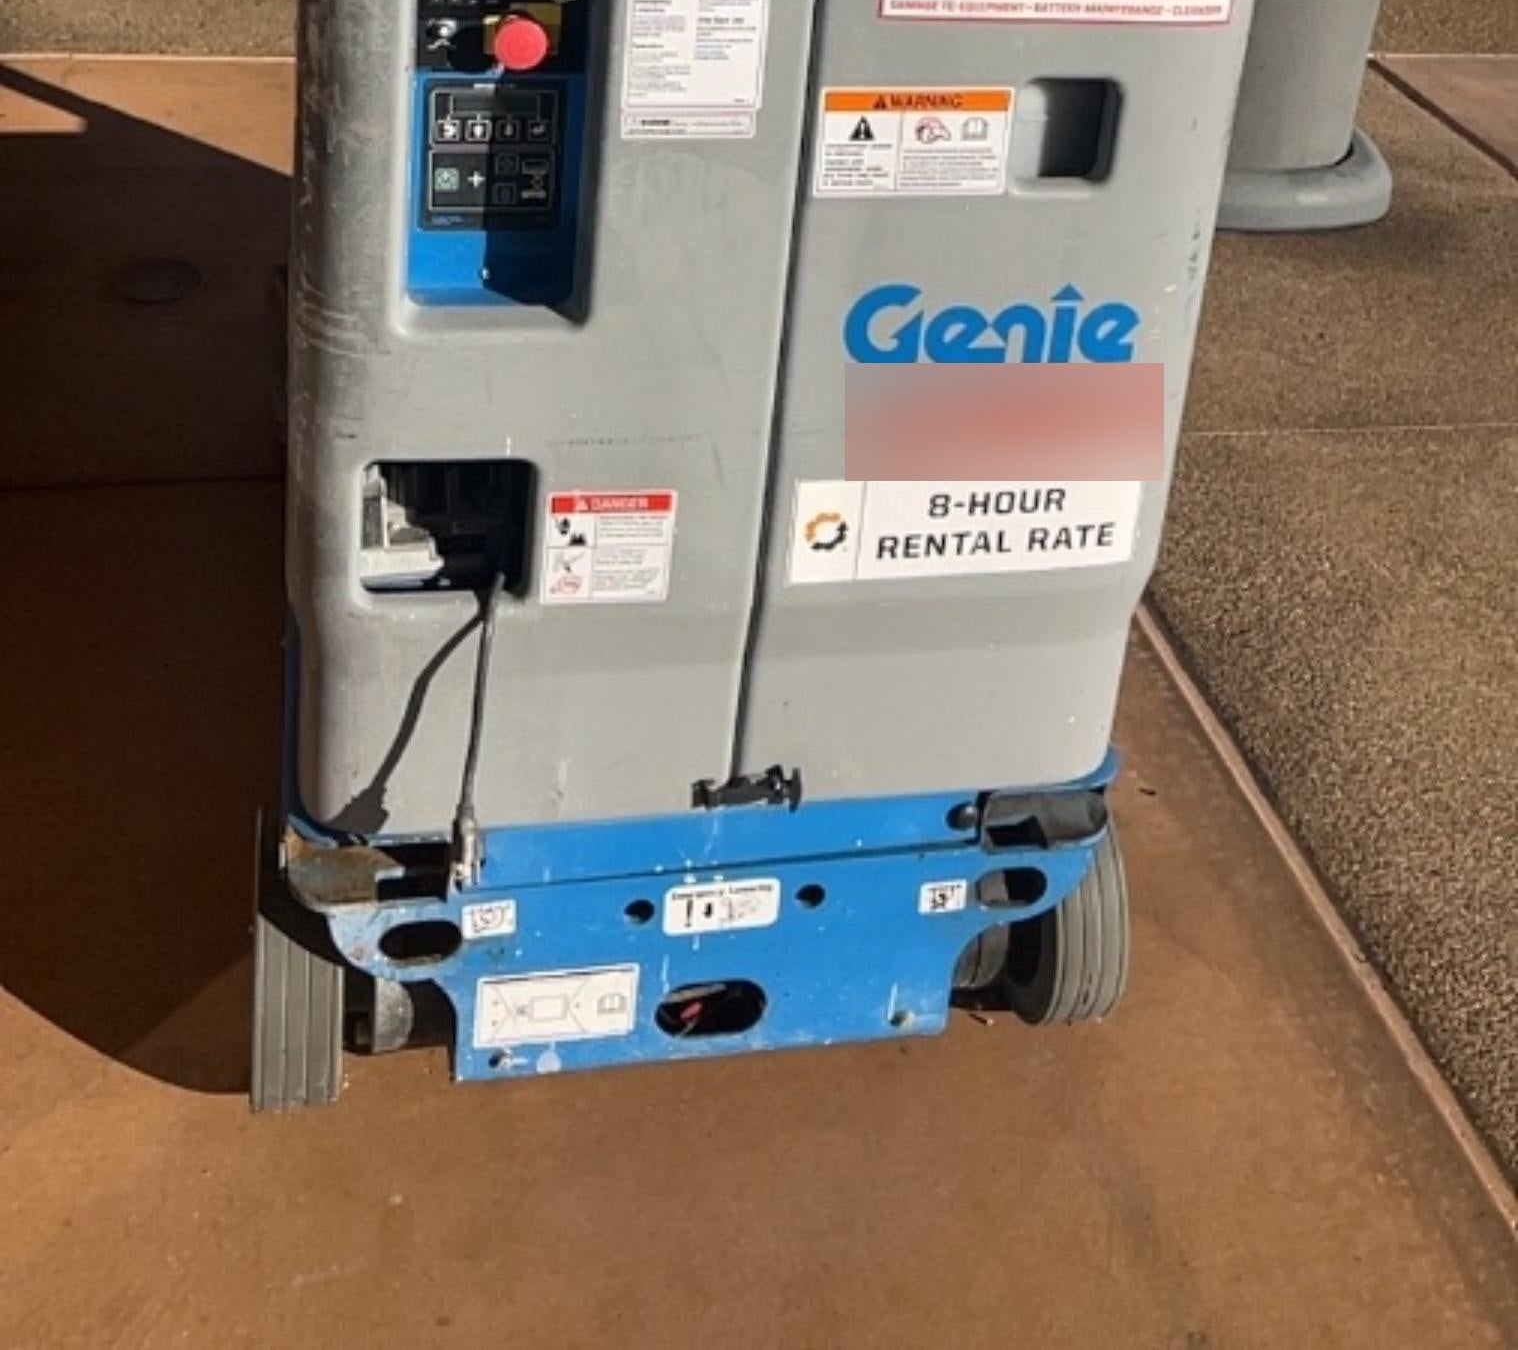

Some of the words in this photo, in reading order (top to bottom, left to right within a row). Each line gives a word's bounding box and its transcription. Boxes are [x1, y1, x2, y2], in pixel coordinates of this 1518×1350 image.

[891, 93, 962, 110] WARNING
[843, 282, 1141, 363] Genie
[928, 488, 1067, 518] 8-HOUR
[876, 531, 1013, 561] RENTAL
[1027, 521, 1116, 548] RATE
